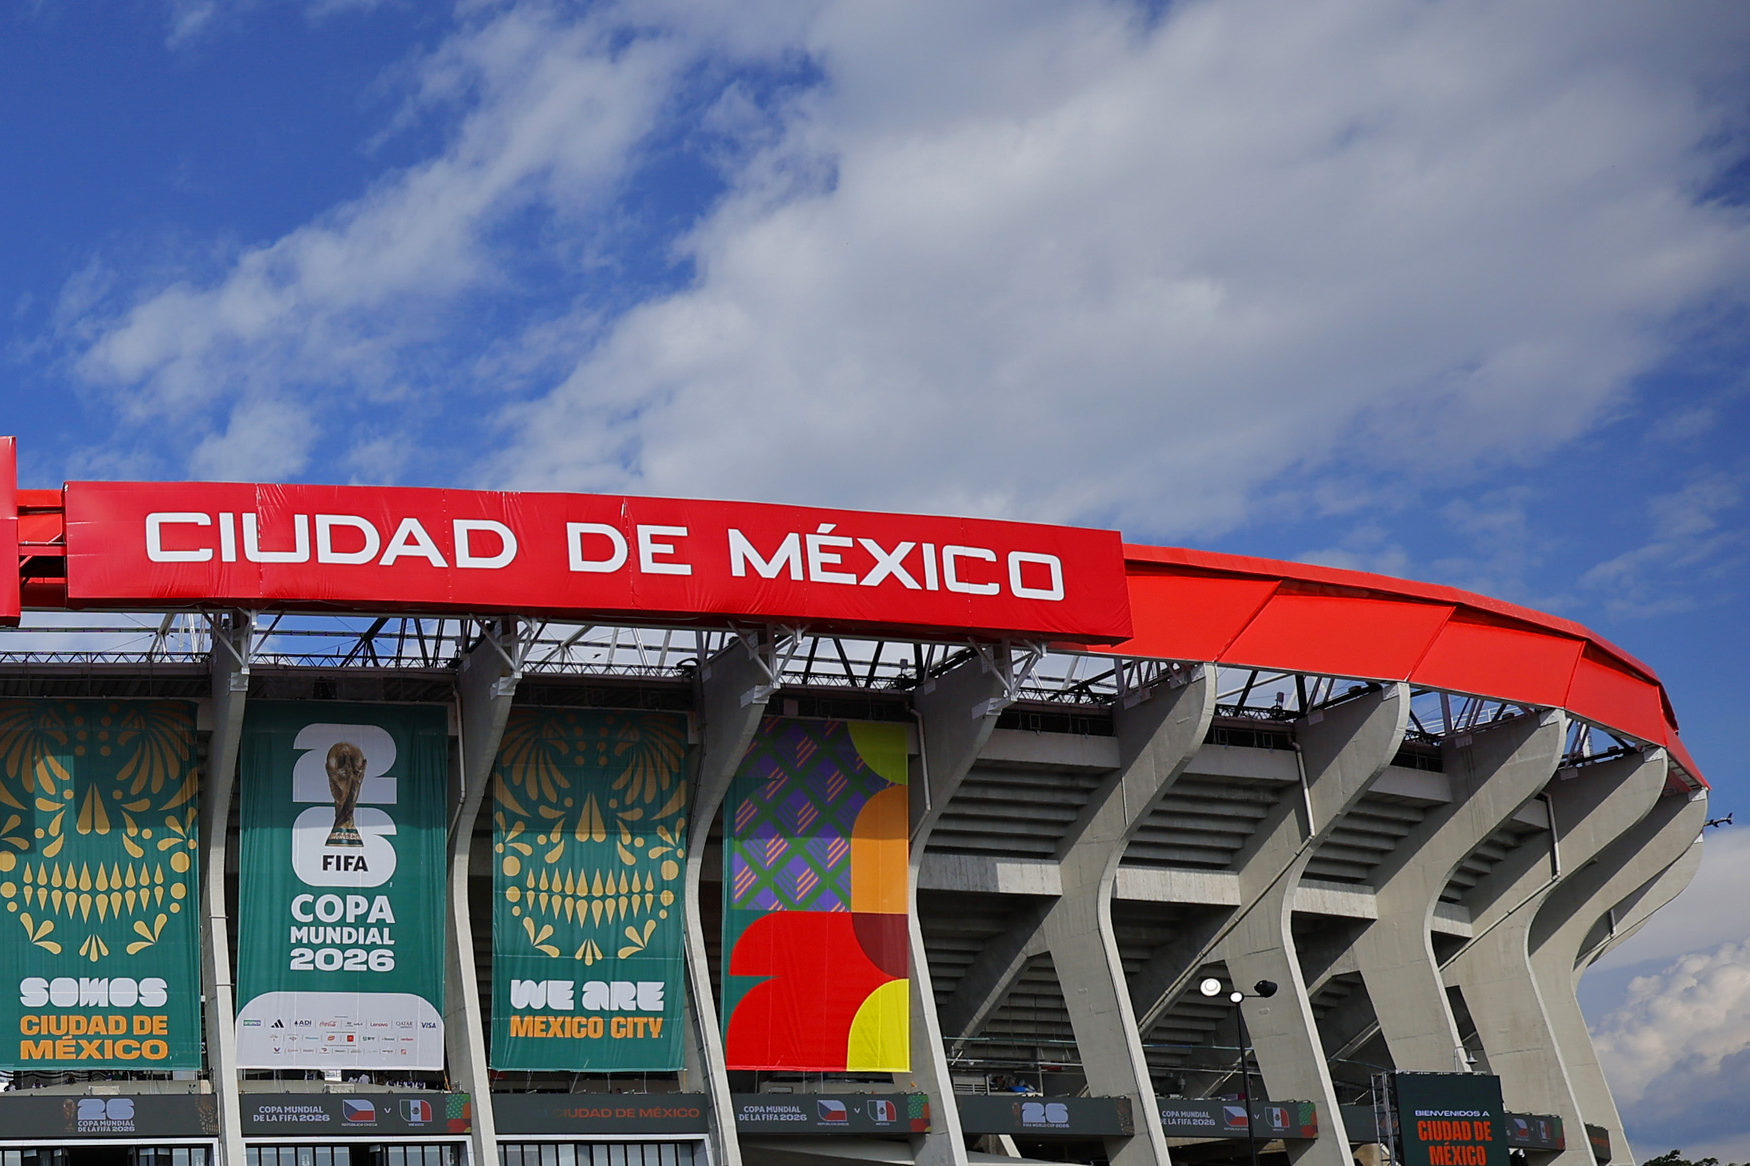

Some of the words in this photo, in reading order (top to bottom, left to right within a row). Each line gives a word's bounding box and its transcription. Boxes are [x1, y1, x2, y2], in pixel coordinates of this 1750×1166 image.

[144, 512, 518, 570] CIUDAD
[567, 522, 692, 577] DE
[728, 522, 1066, 603] MÉXICO
[322, 855, 368, 872] FIFA
[290, 893, 394, 924] COPA
[290, 926, 395, 946] MUNDIAL
[289, 948, 395, 971] 2026
[19, 977, 168, 1008] SOMOS
[509, 980, 575, 1011] WE
[581, 980, 666, 1011] ARE
[19, 1014, 127, 1036] CIUDAD
[132, 1014, 168, 1036] DE
[509, 1016, 606, 1039] MEXICO
[611, 1016, 663, 1039] CITY
[19, 1035, 169, 1060] MÉXICO
[253, 1114, 264, 1122] DE
[266, 1114, 278, 1122] LA
[280, 1114, 298, 1122] FIFA
[299, 1114, 331, 1122] 2026
[615, 1108, 636, 1118] DE
[639, 1106, 701, 1118] MÉXICO
[766, 1106, 801, 1114] MUNDIAL
[779, 1114, 808, 1122] 2026
[1162, 1110, 1180, 1118] COPA
[1181, 1111, 1210, 1119] MUNDIAL
[1414, 1109, 1480, 1117] BIENVENIDOS
[1416, 1120, 1471, 1141] CIUDAD
[1474, 1120, 1493, 1141] DE
[1428, 1141, 1488, 1166] MÉXICO
